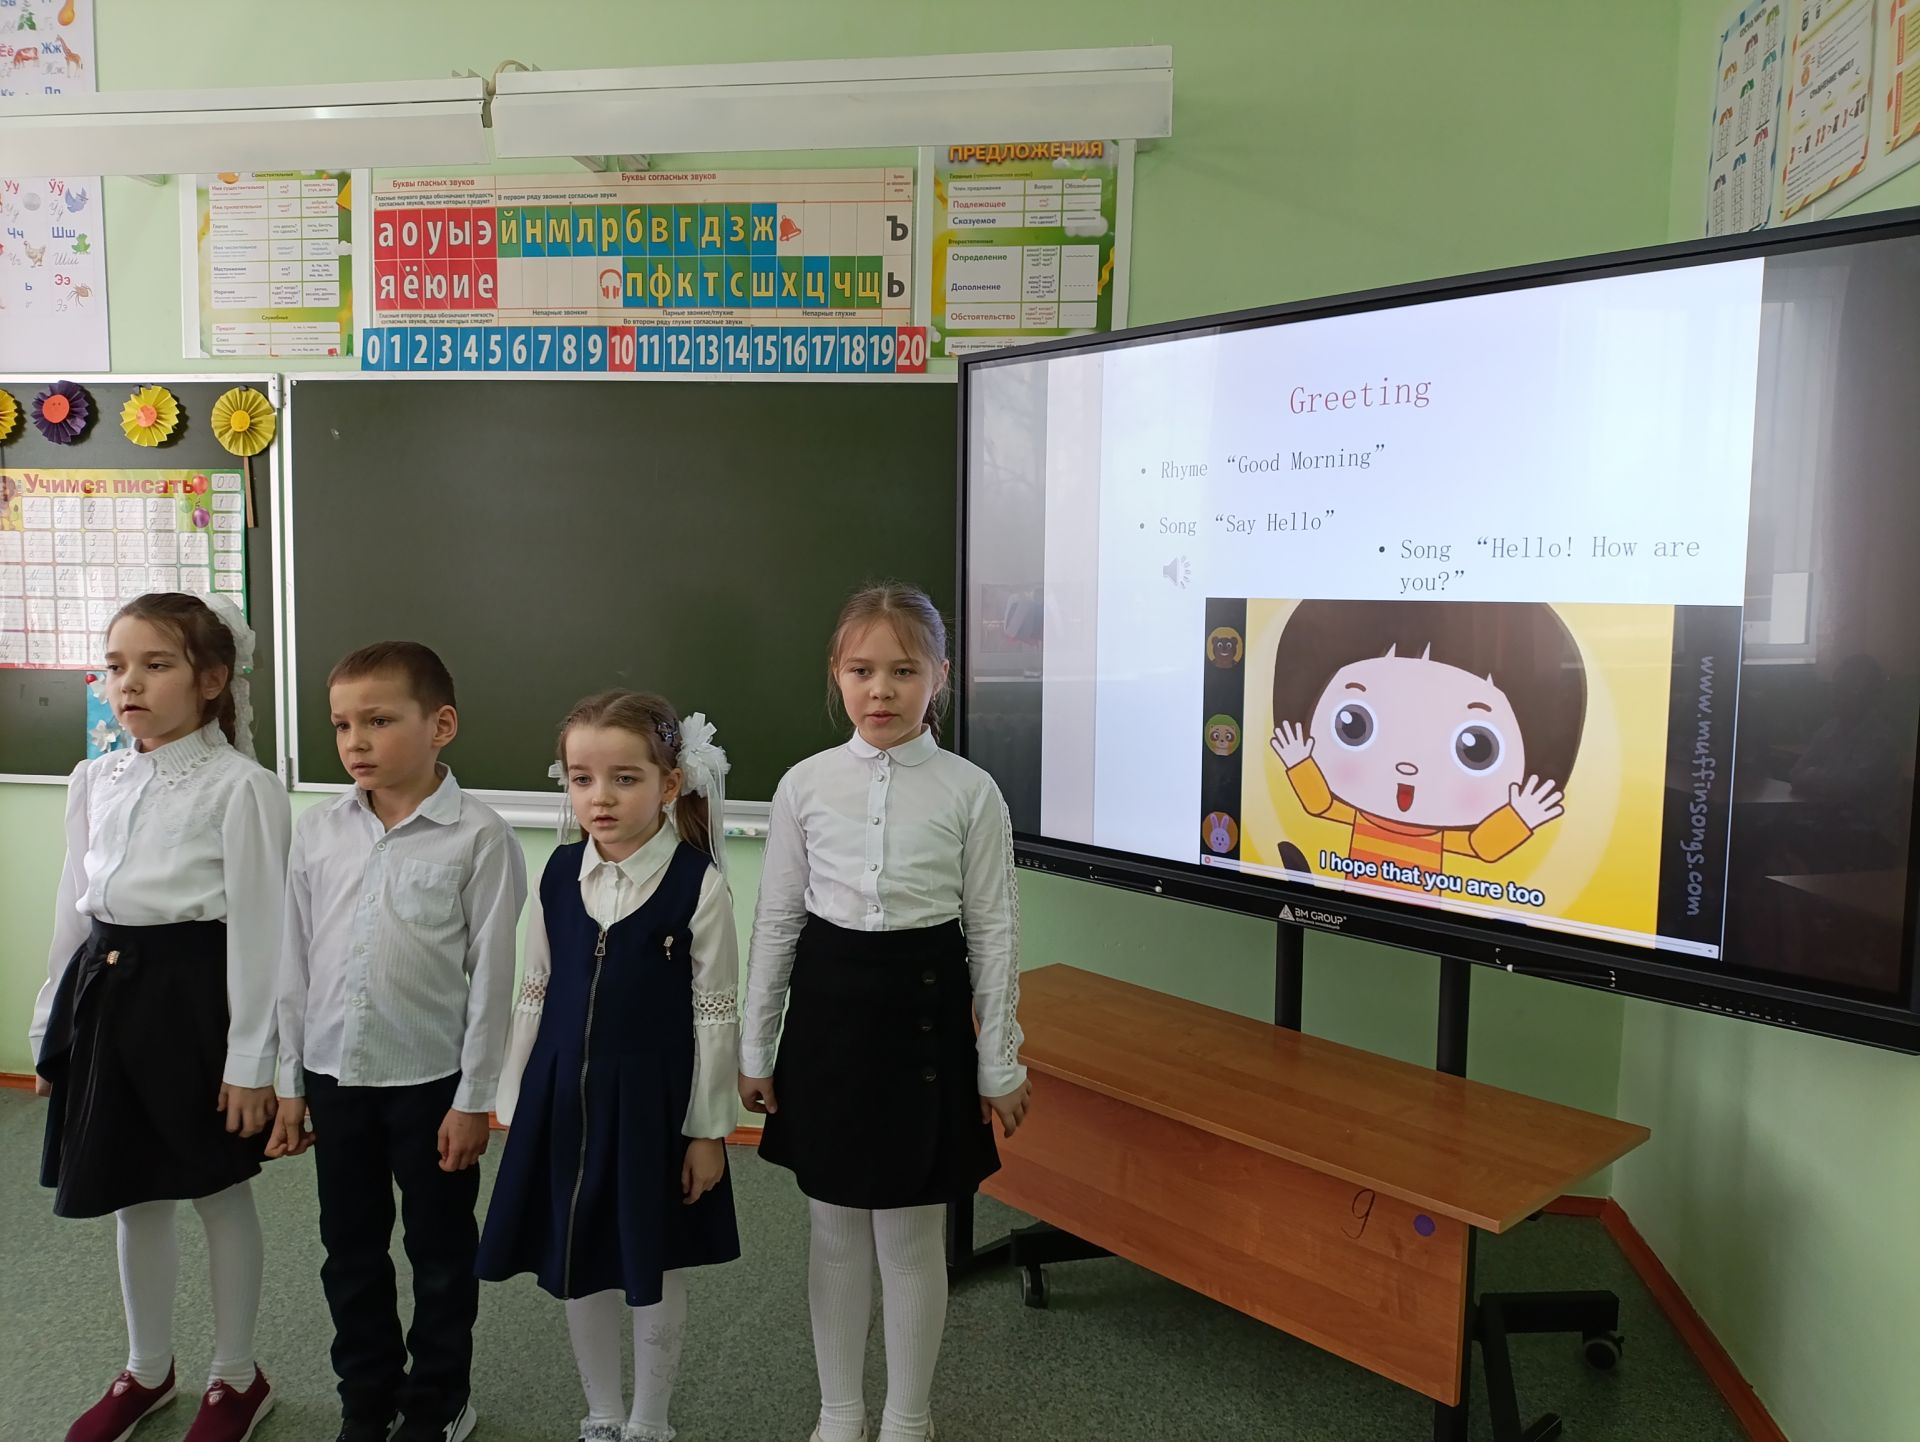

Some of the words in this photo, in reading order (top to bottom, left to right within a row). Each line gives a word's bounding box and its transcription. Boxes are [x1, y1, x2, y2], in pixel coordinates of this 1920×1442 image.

[949, 141, 1104, 163] ПРЕДЛОЖЕНИЯ
[392, 180, 415, 189] Буквы
[449, 179, 475, 187] звуков
[621, 173, 646, 182] Буквы
[648, 173, 688, 181] согласных
[691, 172, 716, 182] звуков
[953, 200, 1006, 209] Подлежащее
[952, 217, 997, 227] Сказуемое
[52, 226, 76, 238] Шш
[952, 253, 1007, 263] Определение
[951, 283, 1001, 291] Дополнение
[951, 313, 1016, 321] Обстоятельство
[367, 335, 380, 364] 0
[391, 335, 400, 363] 1
[414, 335, 428, 364] 2
[439, 335, 452, 364] 3
[464, 335, 478, 364] 4
[489, 335, 501, 364] 5
[513, 335, 527, 364] 6
[538, 335, 551, 364] 7
[563, 335, 577, 364] 8
[588, 335, 602, 364] 9
[611, 335, 634, 365] 10
[639, 335, 660, 365] 11
[667, 335, 690, 365] 12
[696, 335, 719, 365] 13
[725, 335, 749, 365] 14
[754, 335, 777, 365] 15
[783, 335, 807, 365] 16
[812, 335, 835, 365] 17
[841, 335, 865, 365] 18
[870, 335, 895, 365] 19
[898, 335, 925, 365] 20
[1290, 377, 1431, 414] Greeting
[1161, 461, 1208, 480] Rhyme
[1227, 453, 1280, 474] “Good
[1291, 443, 1385, 471] Morning”
[23, 473, 107, 494] Учимся
[113, 479, 195, 494] писать
[1159, 517, 1197, 536] Song
[1215, 513, 1256, 535] “Say
[1267, 509, 1335, 532] Hello”
[1400, 539, 1451, 562] Song
[1477, 536, 1573, 559] “Hello!
[1592, 536, 1638, 558] How
[1654, 540, 1700, 558] are
[1400, 569, 1465, 594] you?”
[1320, 851, 1327, 868] I
[1330, 854, 1377, 878] hope
[1381, 862, 1421, 885] that
[1423, 872, 1462, 891] you
[1466, 878, 1503, 898] are
[1508, 883, 1544, 906] too
[1294, 907, 1309, 919] BM
[1310, 911, 1344, 925] GROUP
